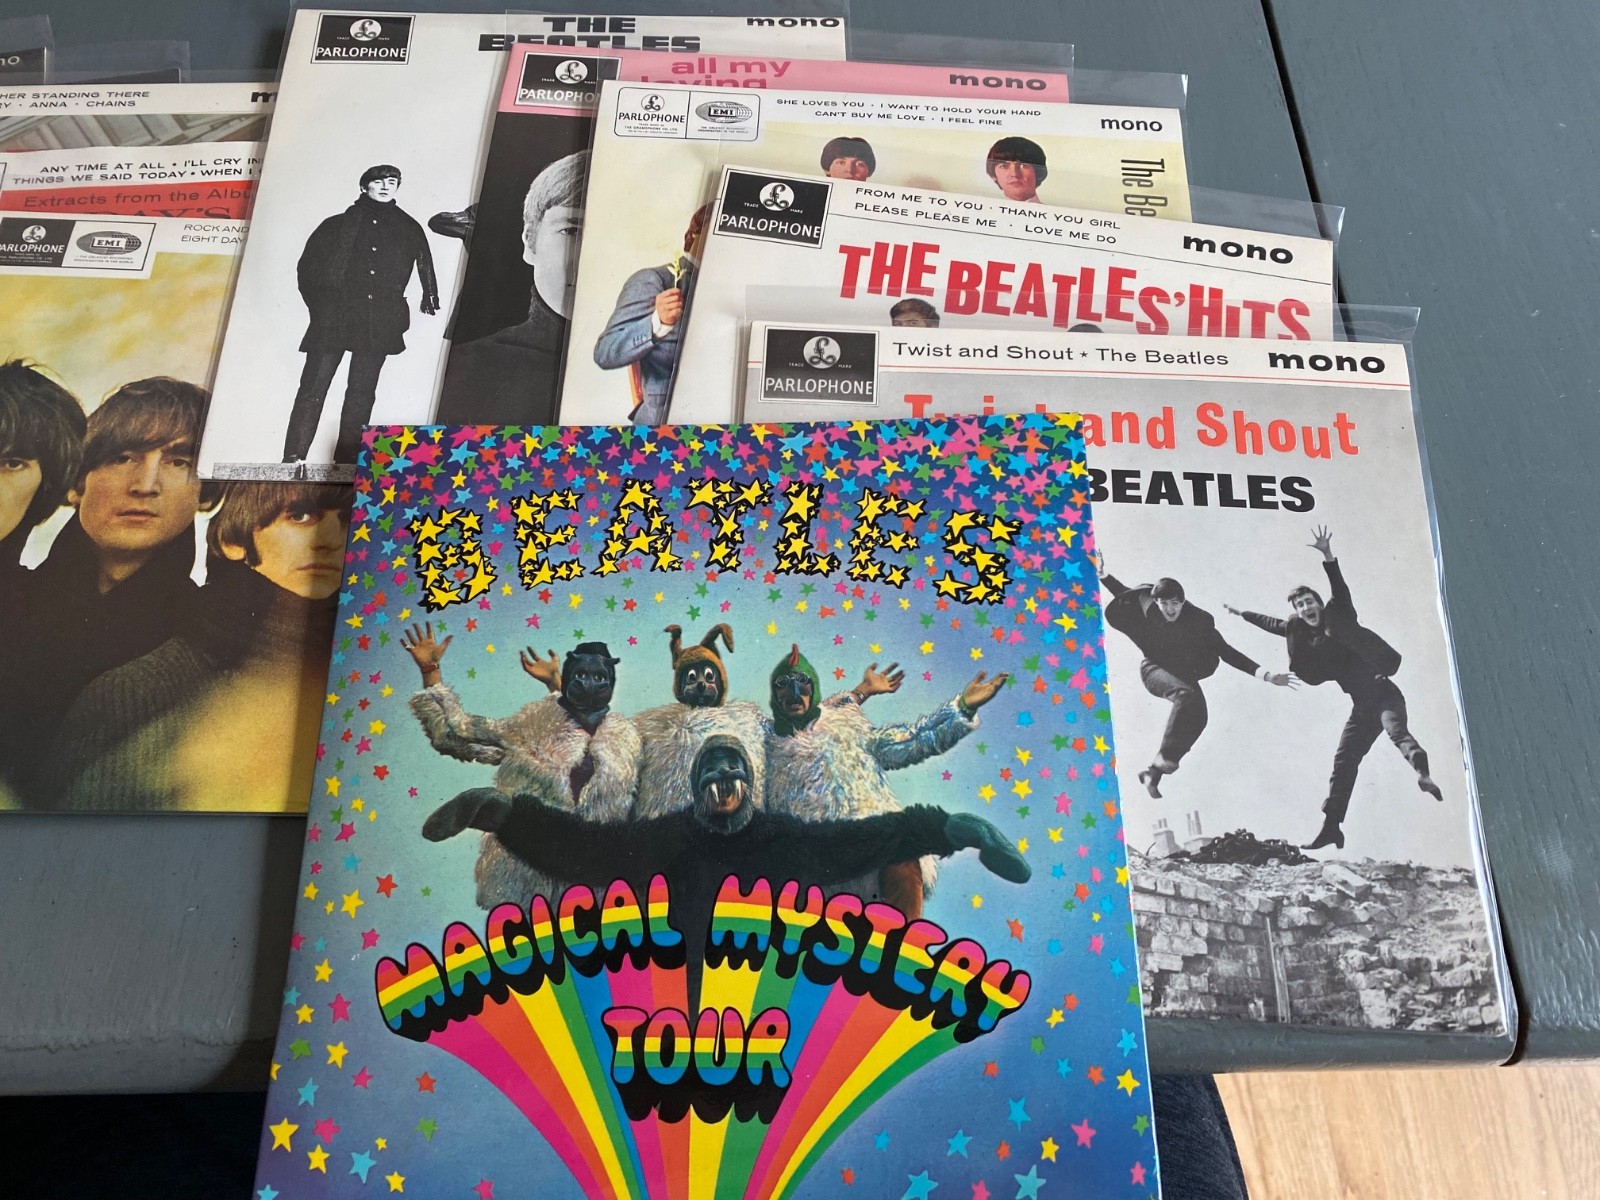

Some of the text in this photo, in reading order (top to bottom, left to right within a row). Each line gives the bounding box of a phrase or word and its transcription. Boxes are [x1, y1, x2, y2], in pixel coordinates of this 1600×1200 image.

[543, 17, 636, 32] THE
[747, 18, 840, 27] mono
[316, 47, 407, 58] PARLOPHONE
[672, 58, 791, 77] all my
[949, 72, 1047, 90] mono
[520, 89, 600, 103] PARLOPHO
[619, 112, 685, 123] PARLOPHONE
[1101, 119, 1162, 132] mono
[13, 176, 64, 184] THINGS
[139, 171, 186, 179] TODAY
[1121, 158, 1165, 188] The
[24, 194, 106, 208] Extracts
[114, 191, 161, 203] from
[169, 192, 199, 201] the
[856, 188, 1121, 230] FROM ME TO YOU THANK YOU GIRL
[184, 224, 220, 232] ROCK
[720, 214, 822, 239] PARLOPHONE
[855, 202, 1117, 244] PLEASE PLEASE ME LOVE ME DO
[0, 244, 65, 253] ARLOPHONE
[1182, 235, 1294, 264] mono
[839, 241, 940, 299] THE
[893, 342, 1228, 365] Twist and Shout The Beatles
[1268, 352, 1386, 374] mono
[766, 378, 873, 395] PARLOPHONE
[1082, 402, 1360, 459] and Shout
[406, 478, 1026, 612] BEATLES
[375, 872, 1031, 1036] MAGICAL MYSTERY
[602, 1006, 792, 1090] TOUR
